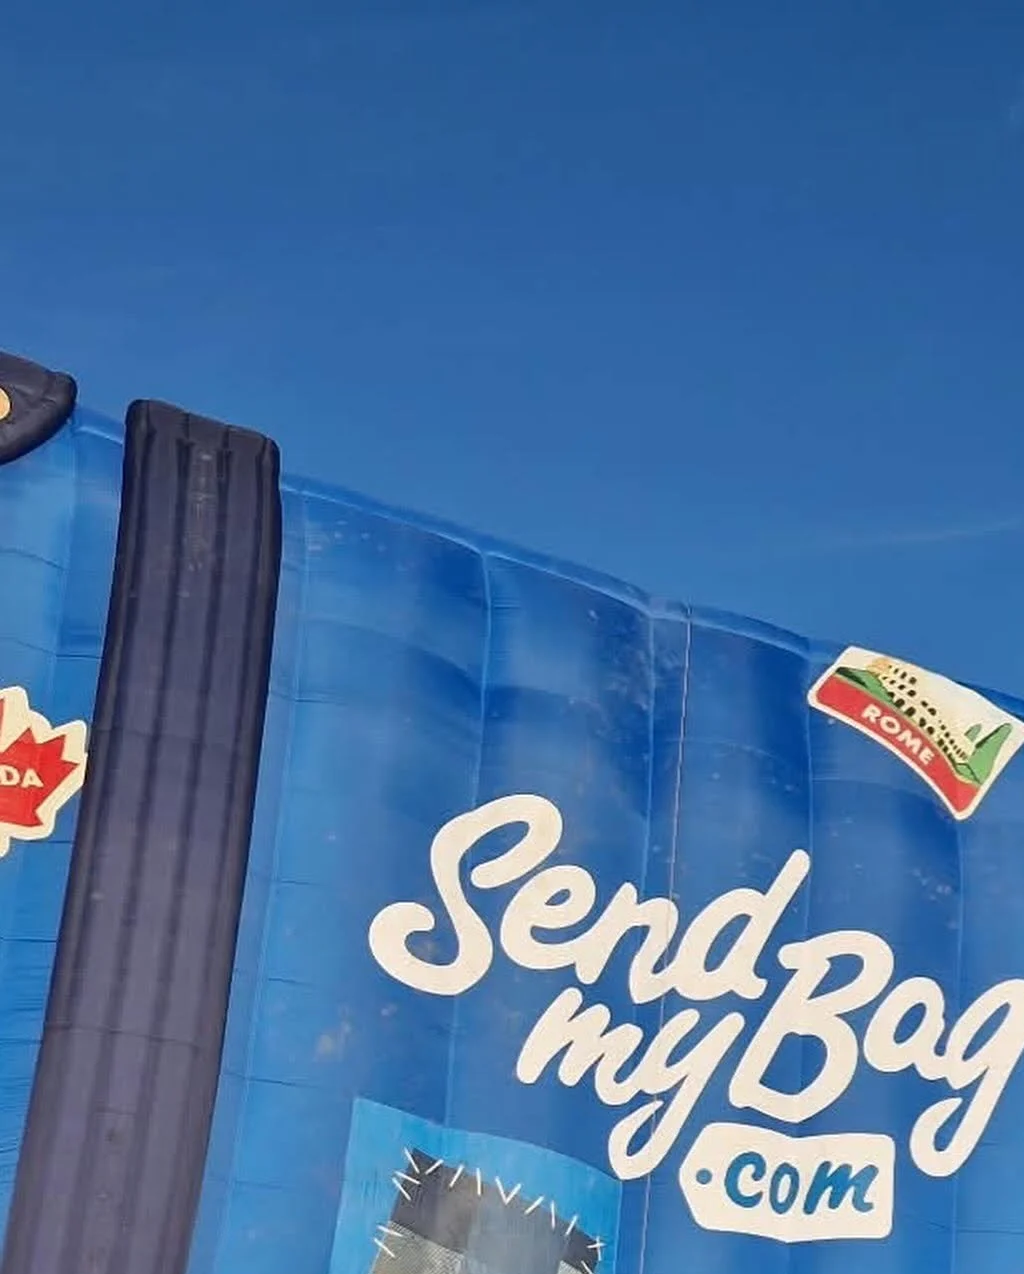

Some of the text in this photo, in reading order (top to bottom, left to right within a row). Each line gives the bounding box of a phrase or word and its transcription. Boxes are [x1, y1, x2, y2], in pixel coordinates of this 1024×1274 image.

[861, 705, 935, 765] ROME
[369, 794, 810, 1003] Send
[516, 987, 745, 1180] my
[695, 1150, 879, 1215] .com
